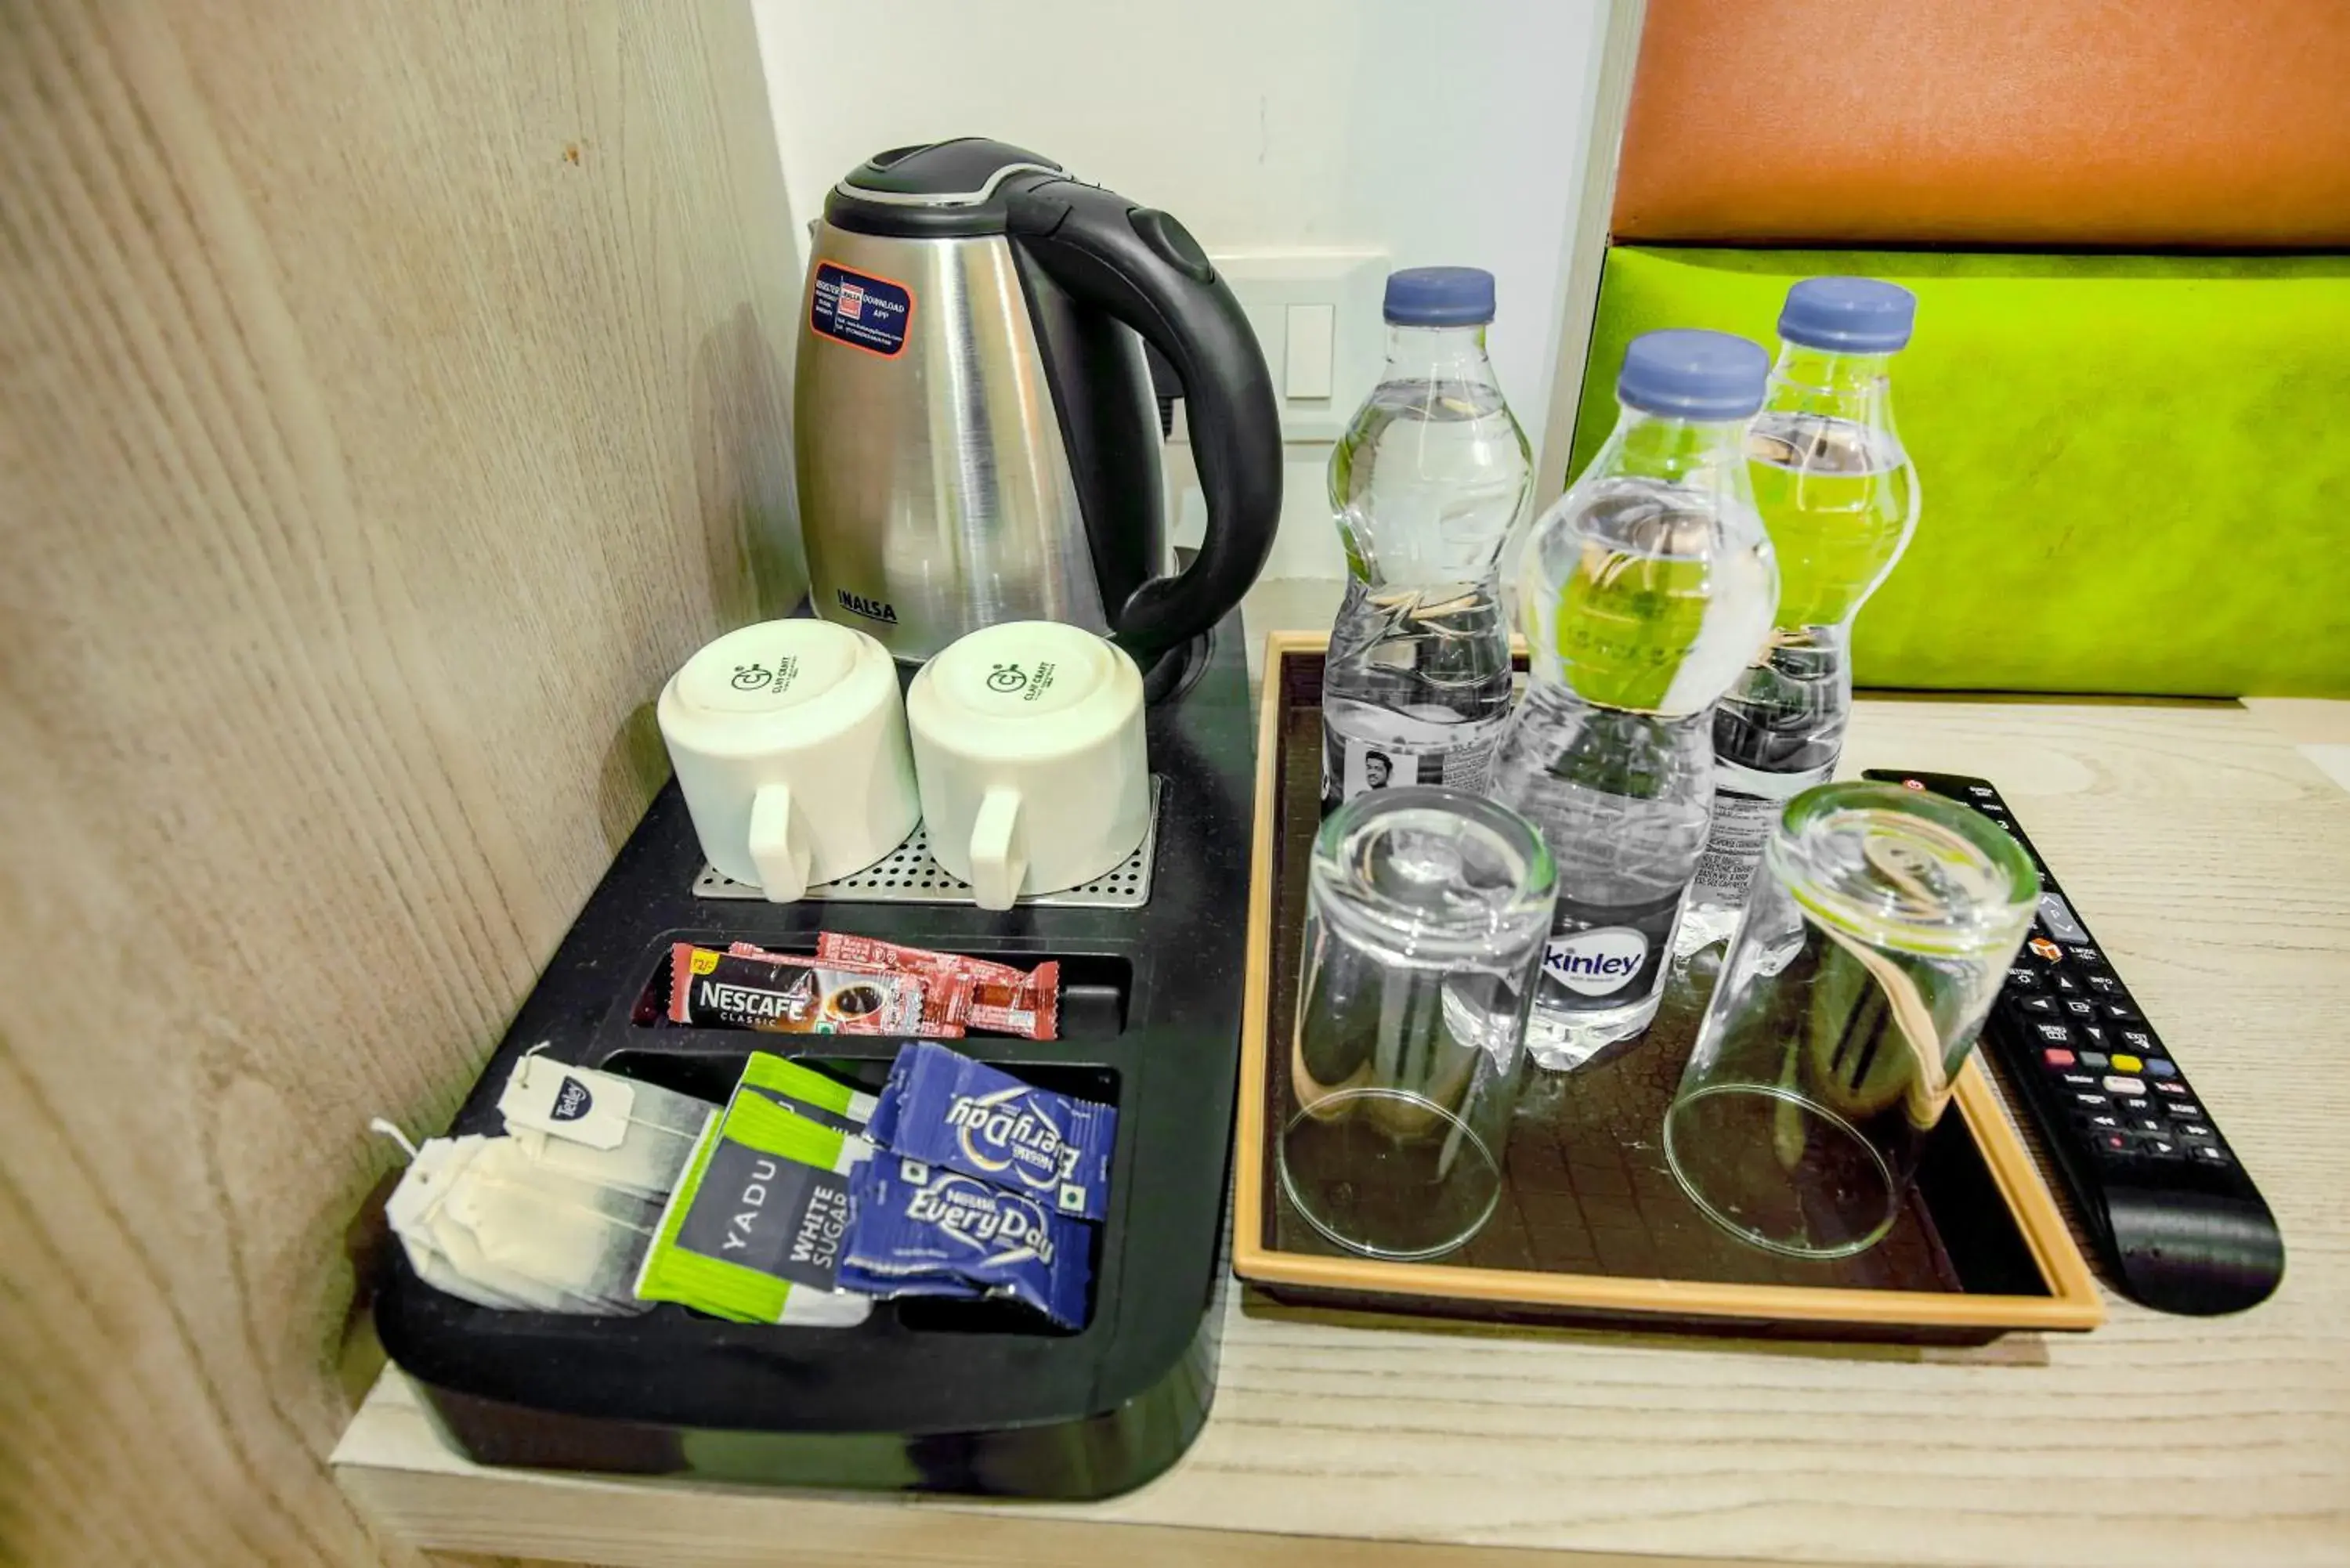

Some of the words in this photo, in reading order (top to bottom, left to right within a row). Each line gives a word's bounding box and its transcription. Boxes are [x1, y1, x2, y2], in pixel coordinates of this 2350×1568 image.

[862, 294, 905, 313] DOWNLOAD
[837, 589, 897, 621] INALSA
[1544, 945, 1641, 976] kinley
[720, 1011, 776, 1026] CLASSIC
[555, 1082, 587, 1117] Tetley
[723, 1159, 776, 1251] YADU
[790, 1185, 833, 1261] WHITE
